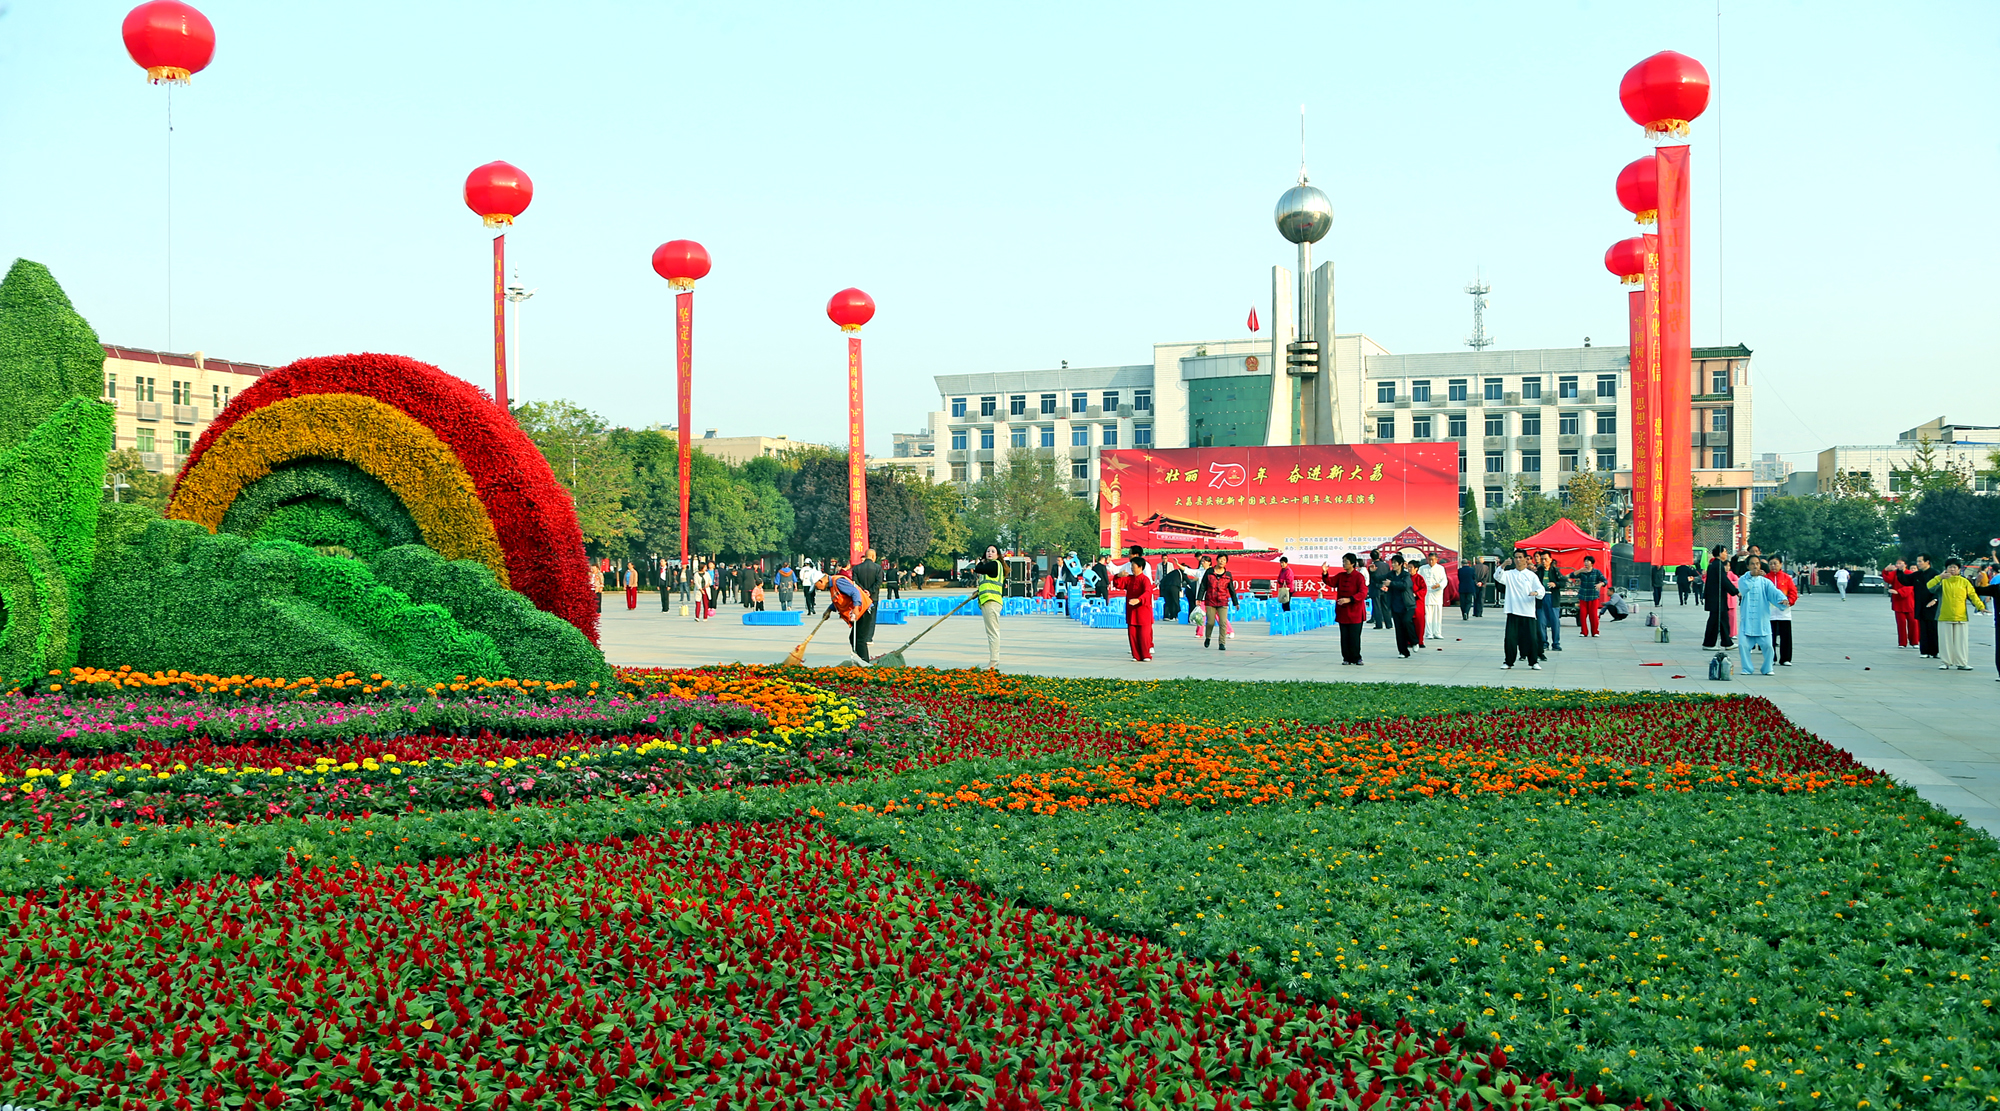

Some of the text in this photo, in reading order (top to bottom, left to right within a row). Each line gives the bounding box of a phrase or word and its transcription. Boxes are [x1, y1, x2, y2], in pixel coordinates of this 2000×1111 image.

[679, 307, 691, 415] 坚定文化自信
[1647, 252, 1662, 382] 坚定文化自信
[1286, 462, 1384, 484] 奋进新大荔
[1635, 430, 1647, 549] 实施旅游旺县战略
